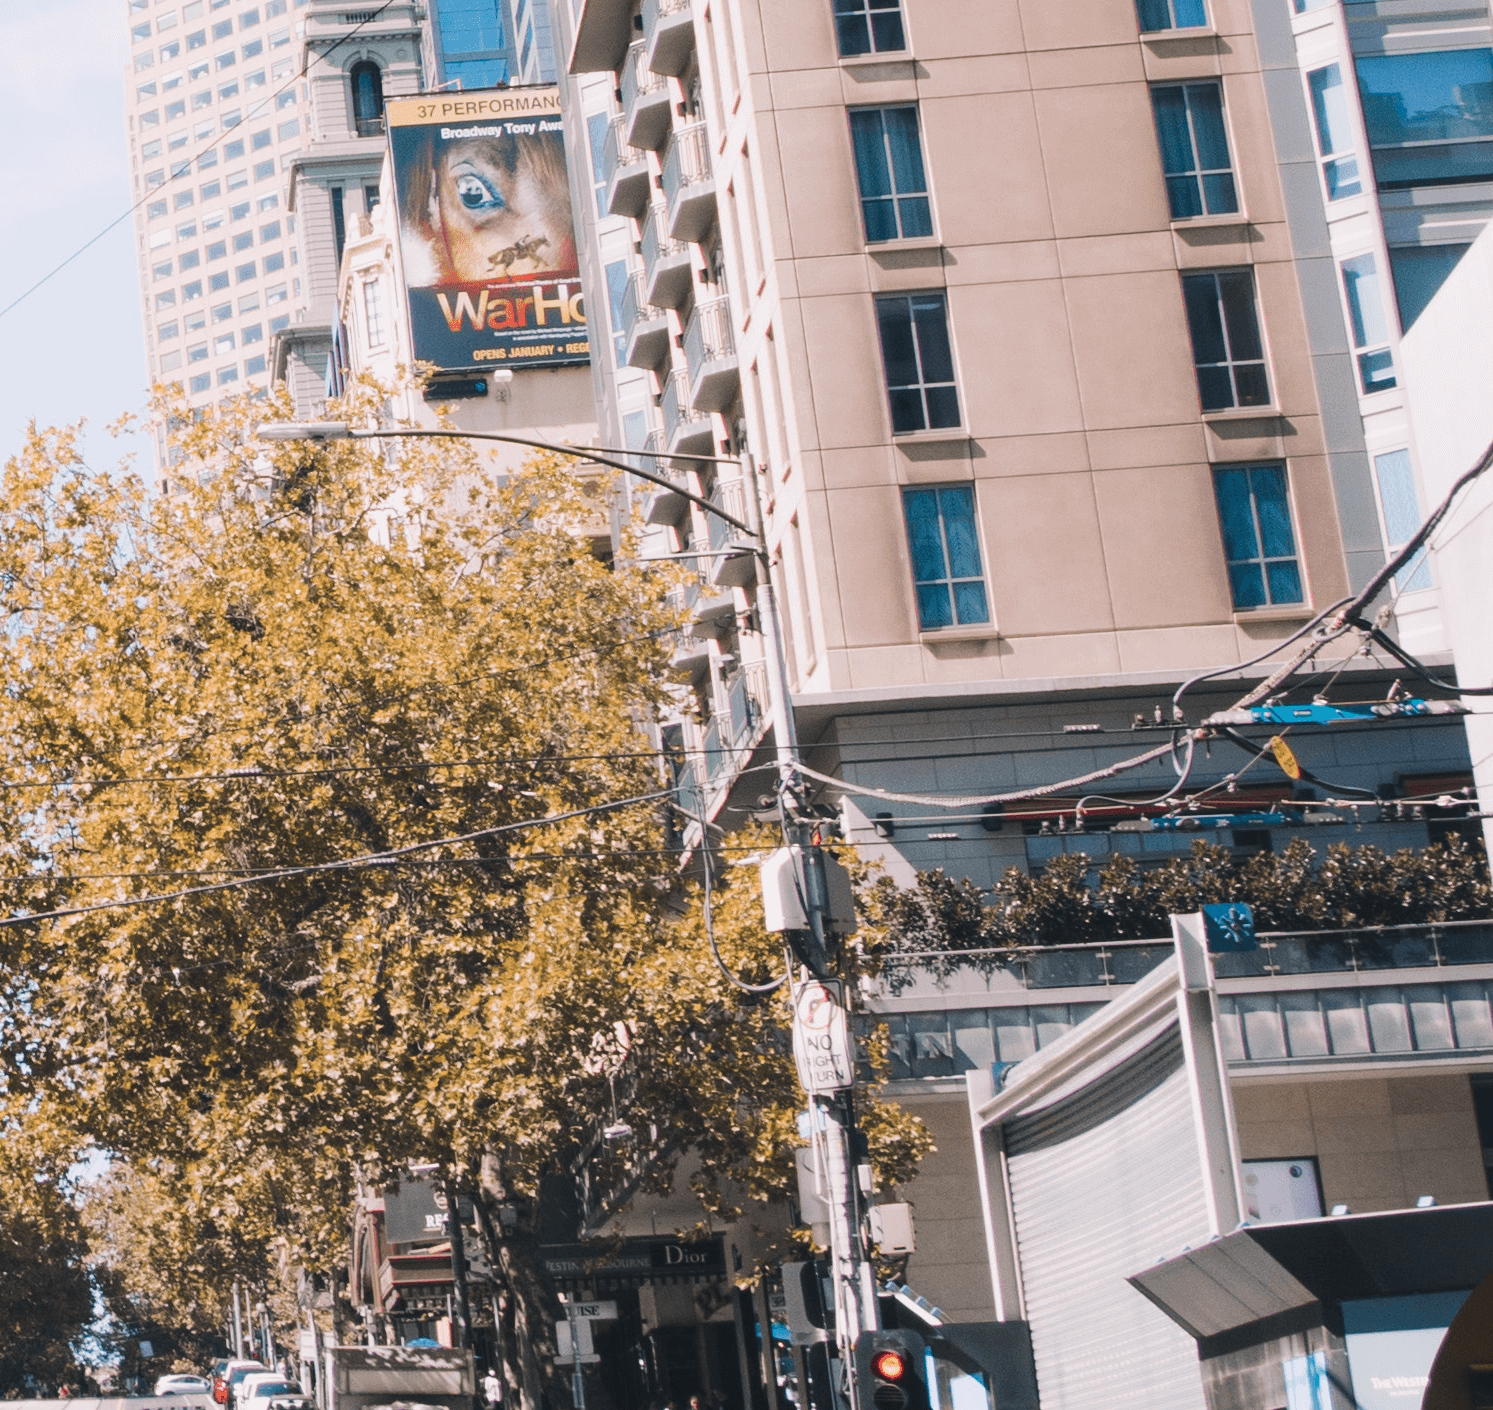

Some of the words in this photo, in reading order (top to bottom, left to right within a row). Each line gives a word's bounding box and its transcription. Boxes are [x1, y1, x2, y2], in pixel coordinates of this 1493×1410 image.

[417, 105, 436, 119] 37
[440, 124, 503, 140] Broadway
[503, 121, 536, 136] Tony
[473, 348, 506, 361] OPENS
[508, 344, 555, 358] JANUARY
[807, 1034, 833, 1051] NO
[665, 1244, 708, 1265] Dior
